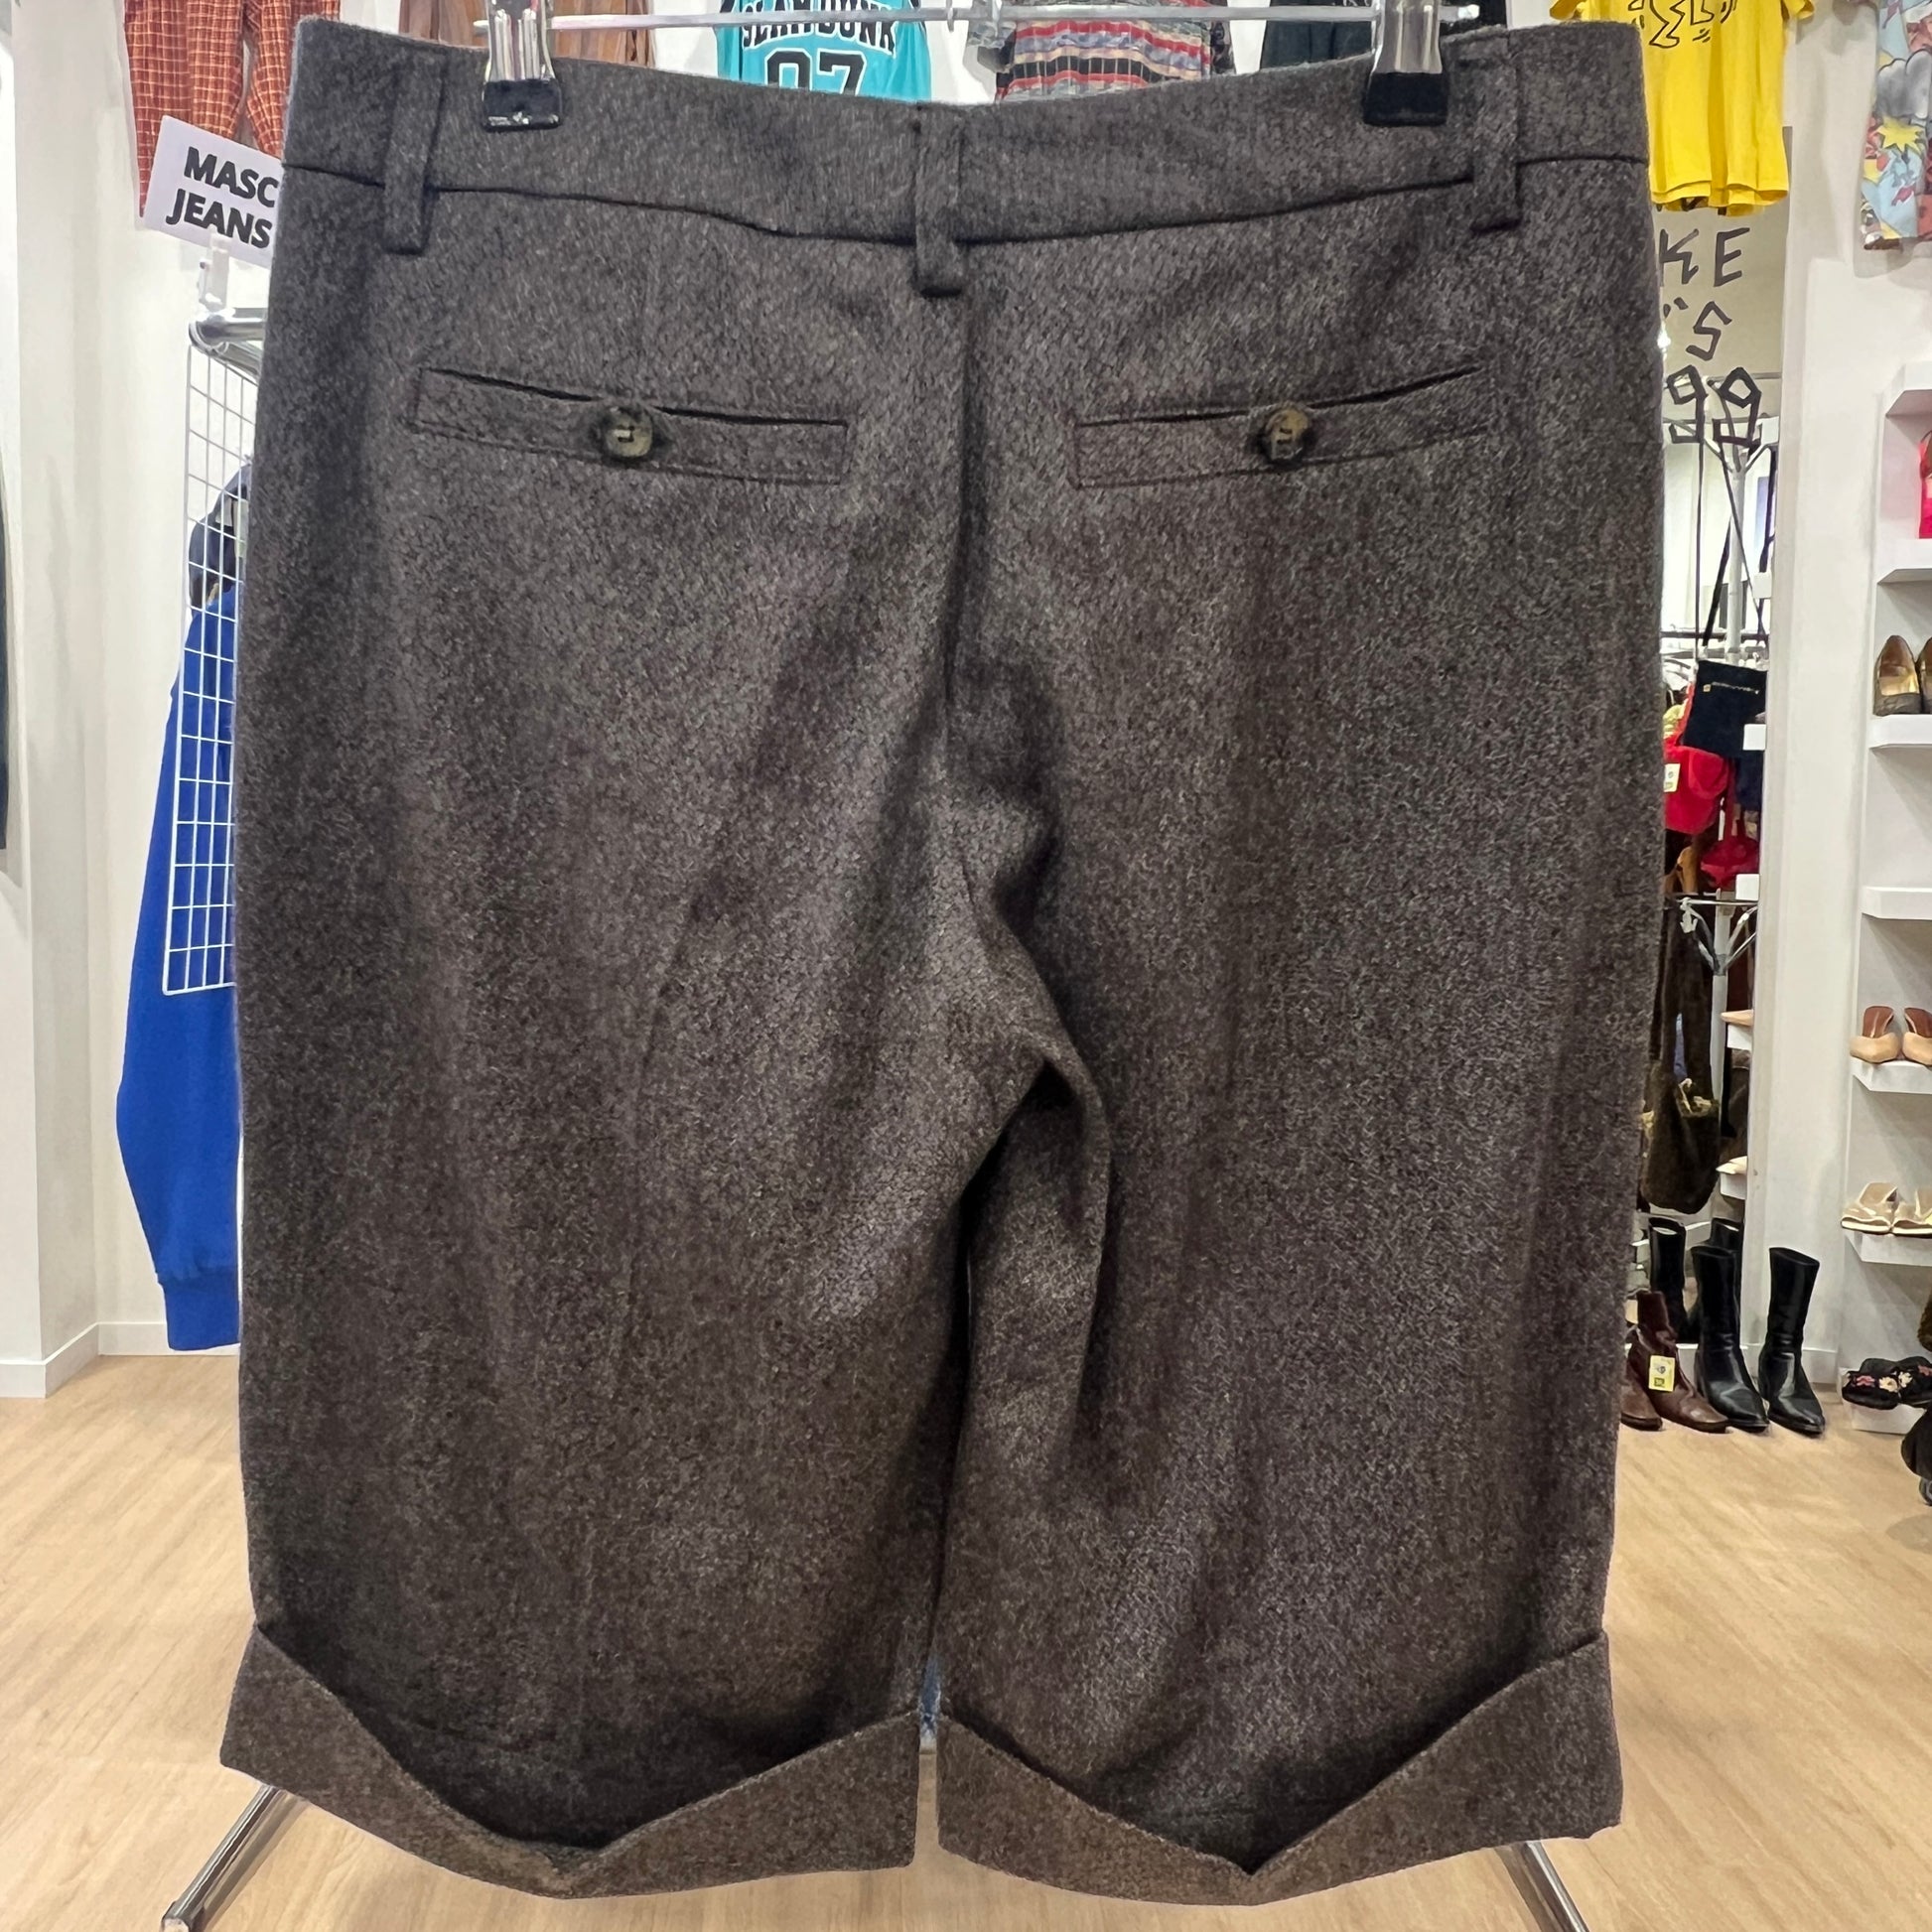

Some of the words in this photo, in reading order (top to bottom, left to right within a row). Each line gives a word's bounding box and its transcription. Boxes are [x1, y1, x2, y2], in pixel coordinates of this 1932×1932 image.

[764, 48, 867, 94] 07
[184, 146, 279, 207] MASC
[165, 188, 273, 249] JEANS
